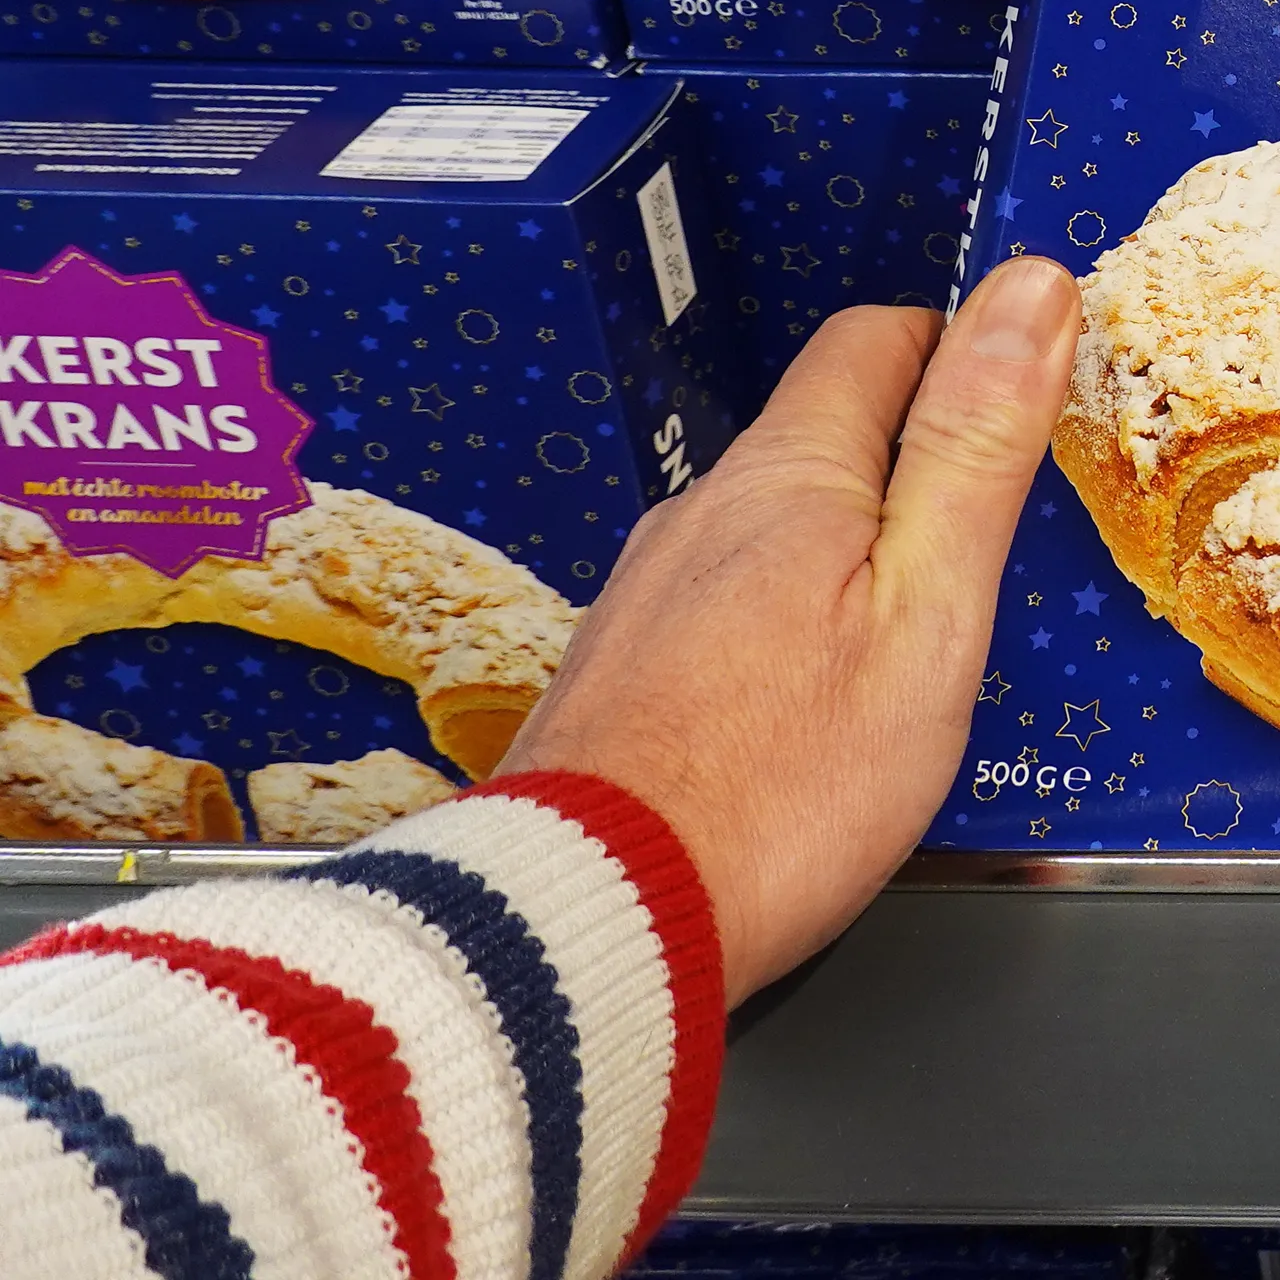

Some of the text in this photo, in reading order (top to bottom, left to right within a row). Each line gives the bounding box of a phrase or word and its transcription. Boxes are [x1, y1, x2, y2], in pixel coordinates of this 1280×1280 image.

[715, 0, 734, 16] G
[0, 335, 222, 387] KERST
[0, 400, 258, 453] KRANS
[975, 760, 1030, 786] 500
[1036, 766, 1058, 789] G
